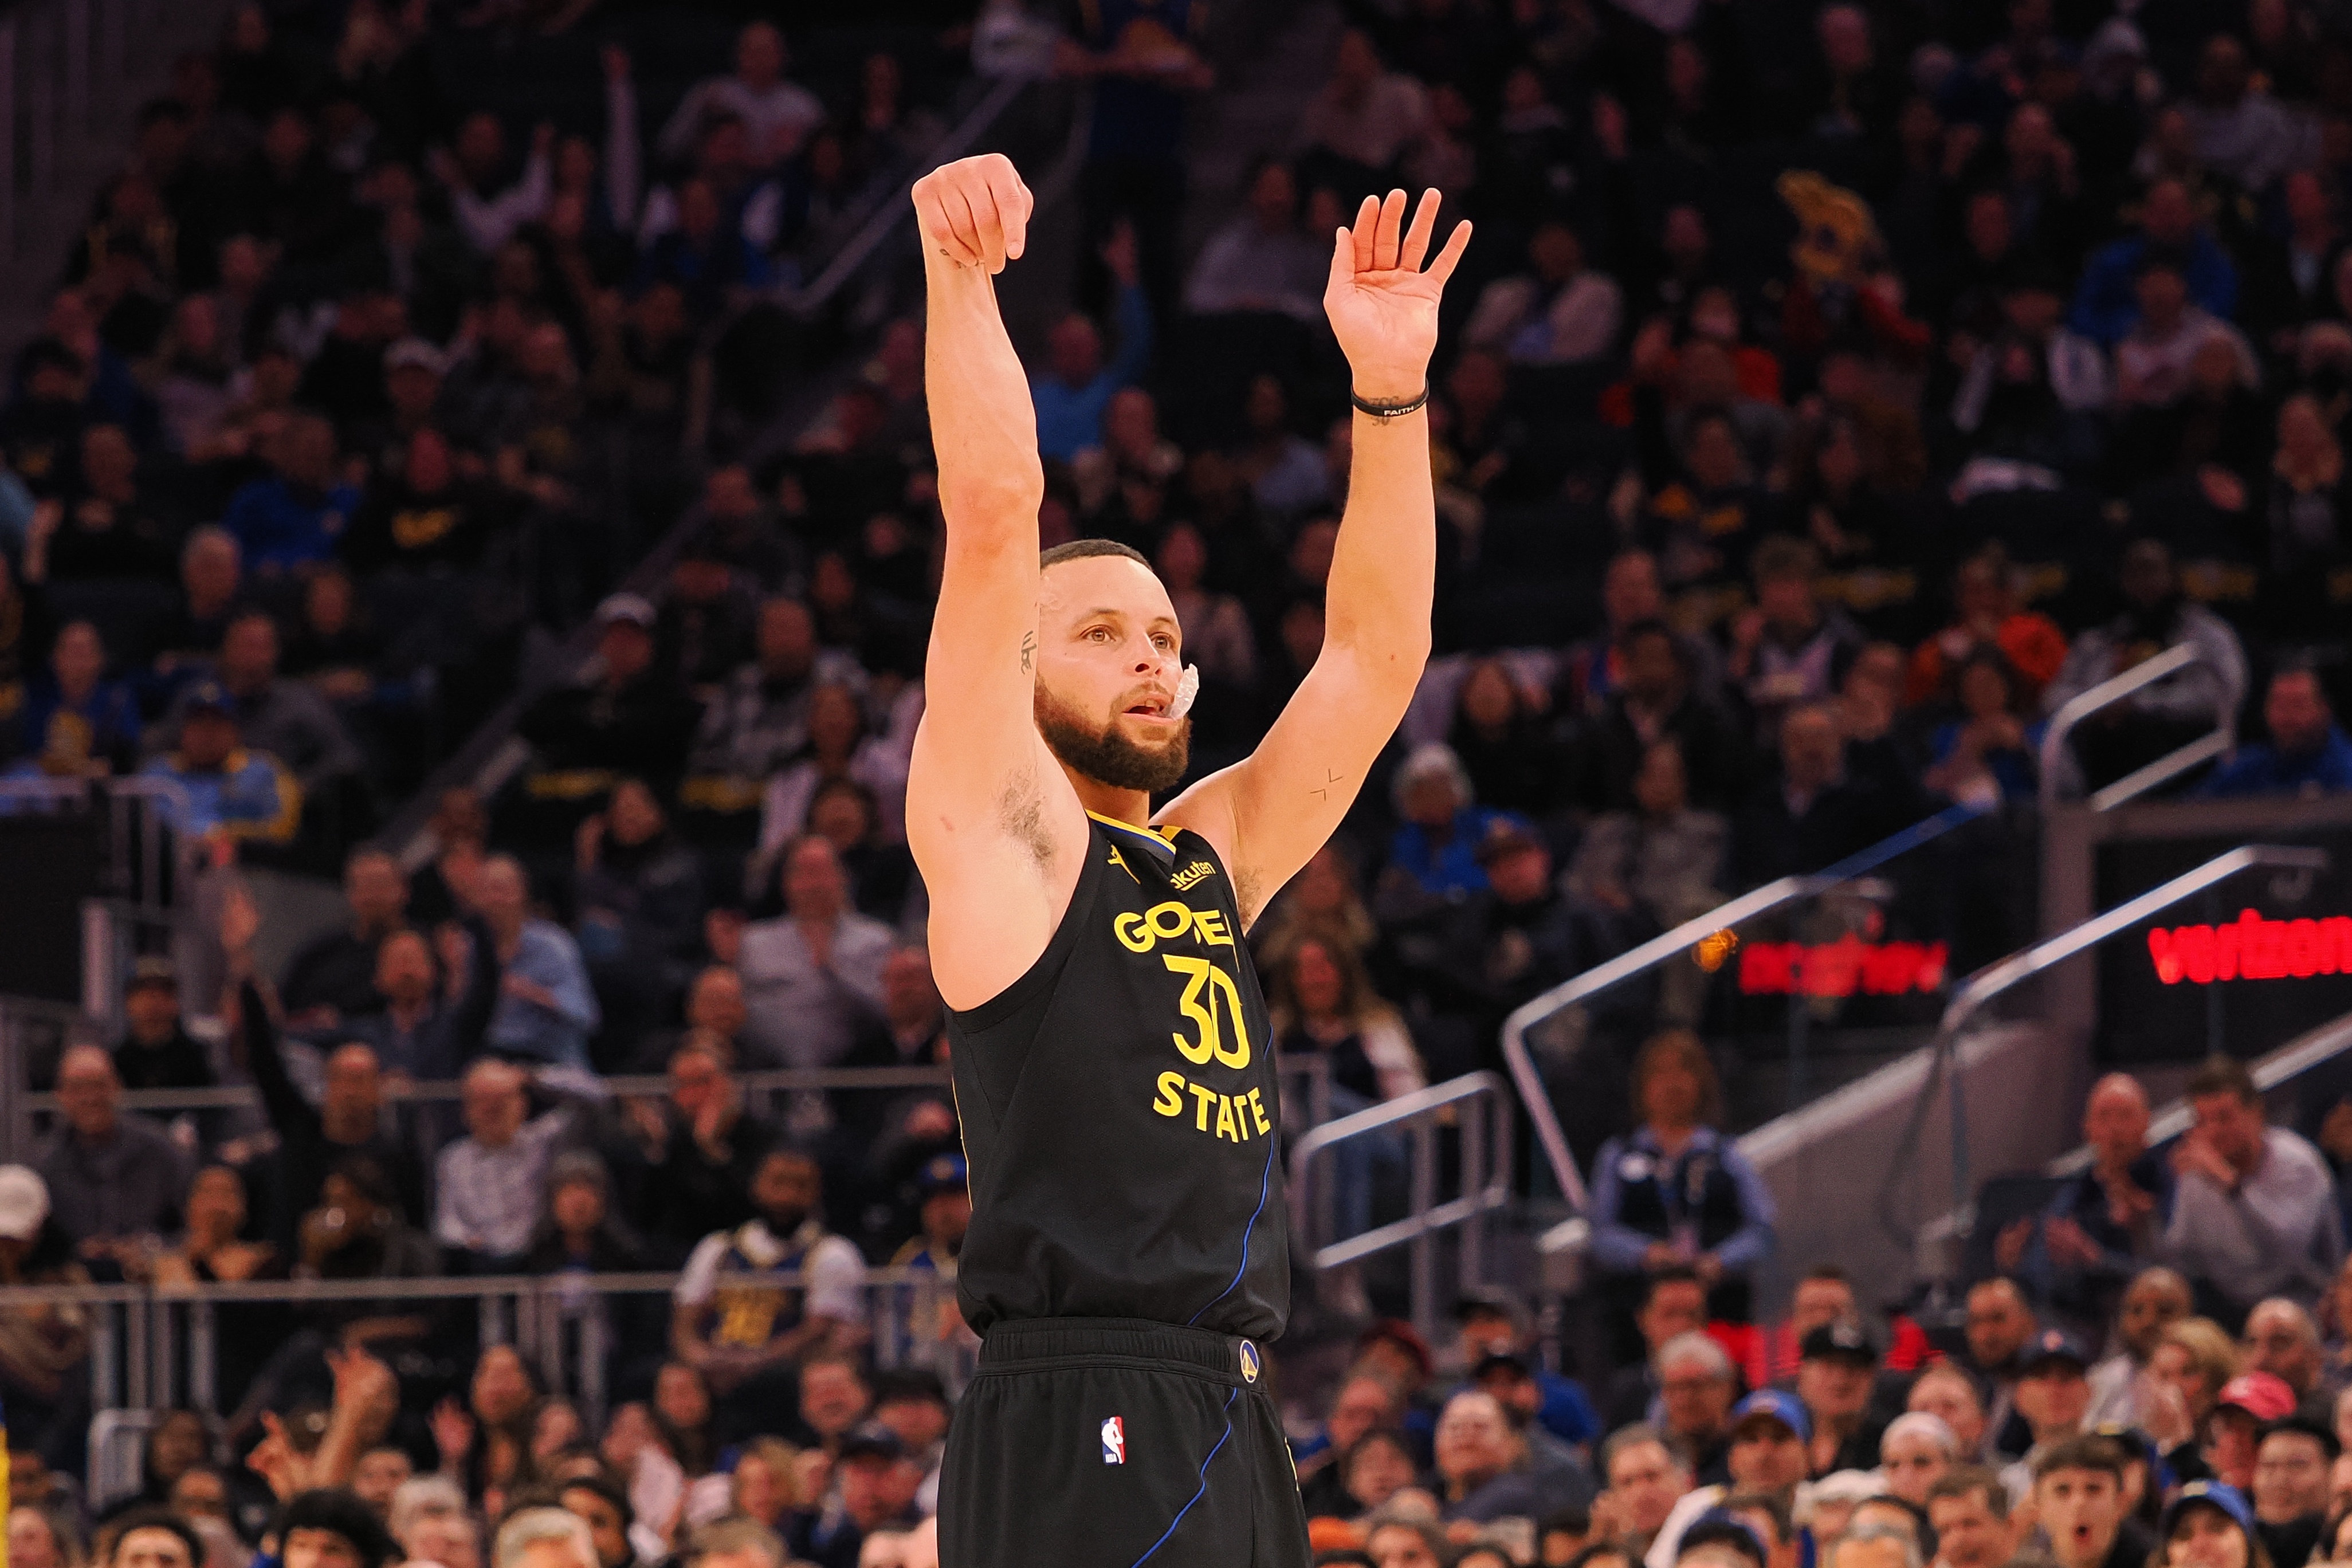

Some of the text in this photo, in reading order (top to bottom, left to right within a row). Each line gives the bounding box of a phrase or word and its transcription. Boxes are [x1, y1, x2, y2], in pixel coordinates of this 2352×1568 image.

[1384, 406, 1414, 416] FAITH
[1170, 861, 1216, 889] akuten
[1162, 954, 1250, 1069] 30
[1153, 1071, 1271, 1143] STATE
[1105, 1453, 1117, 1463] NBA
